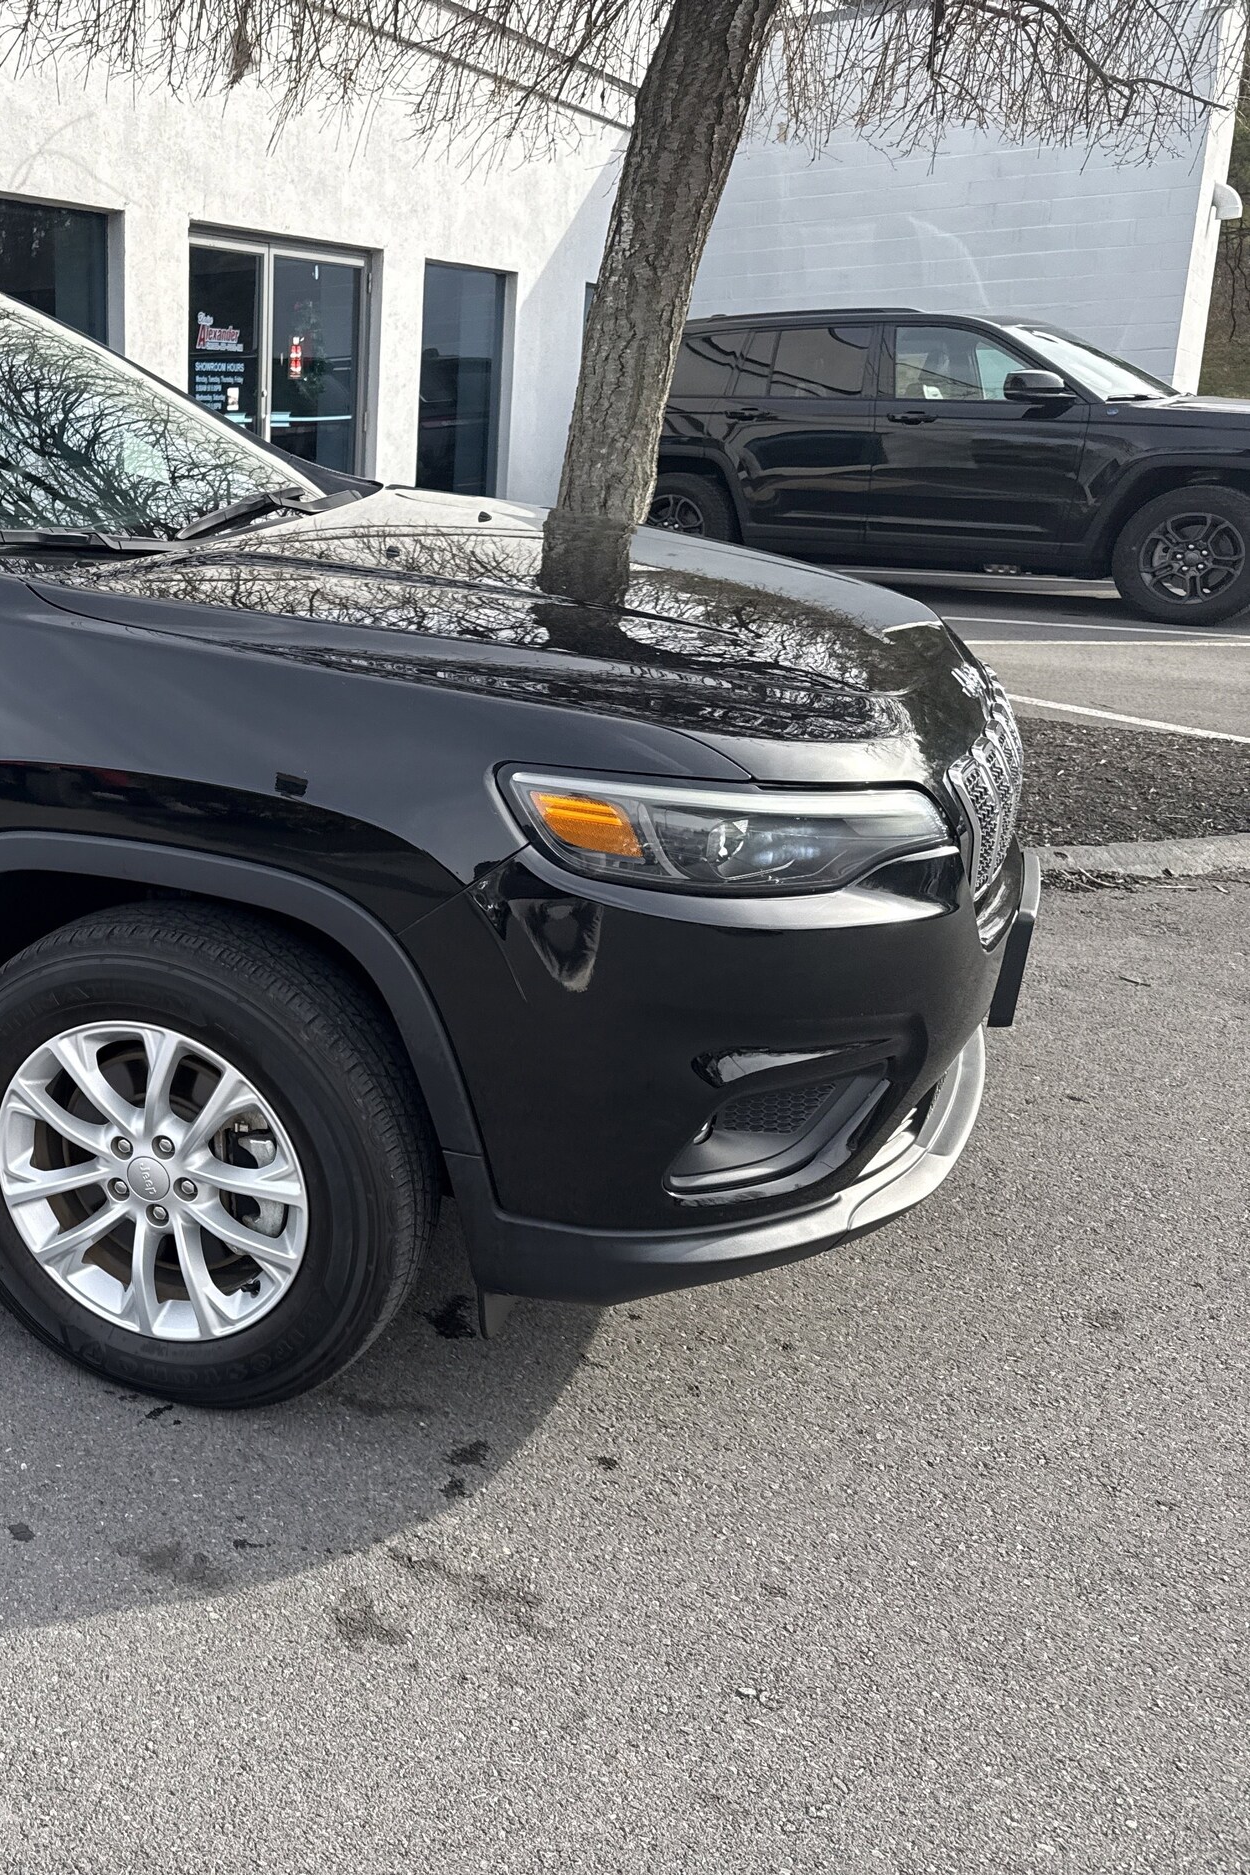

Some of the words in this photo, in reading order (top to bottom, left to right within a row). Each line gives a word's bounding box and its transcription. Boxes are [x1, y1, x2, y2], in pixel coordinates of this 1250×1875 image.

[196, 323, 240, 349] Alexander
[195, 362, 226, 371] SHOWROOM
[227, 362, 244, 372] HOURS
[139, 1162, 157, 1195] Jeep
